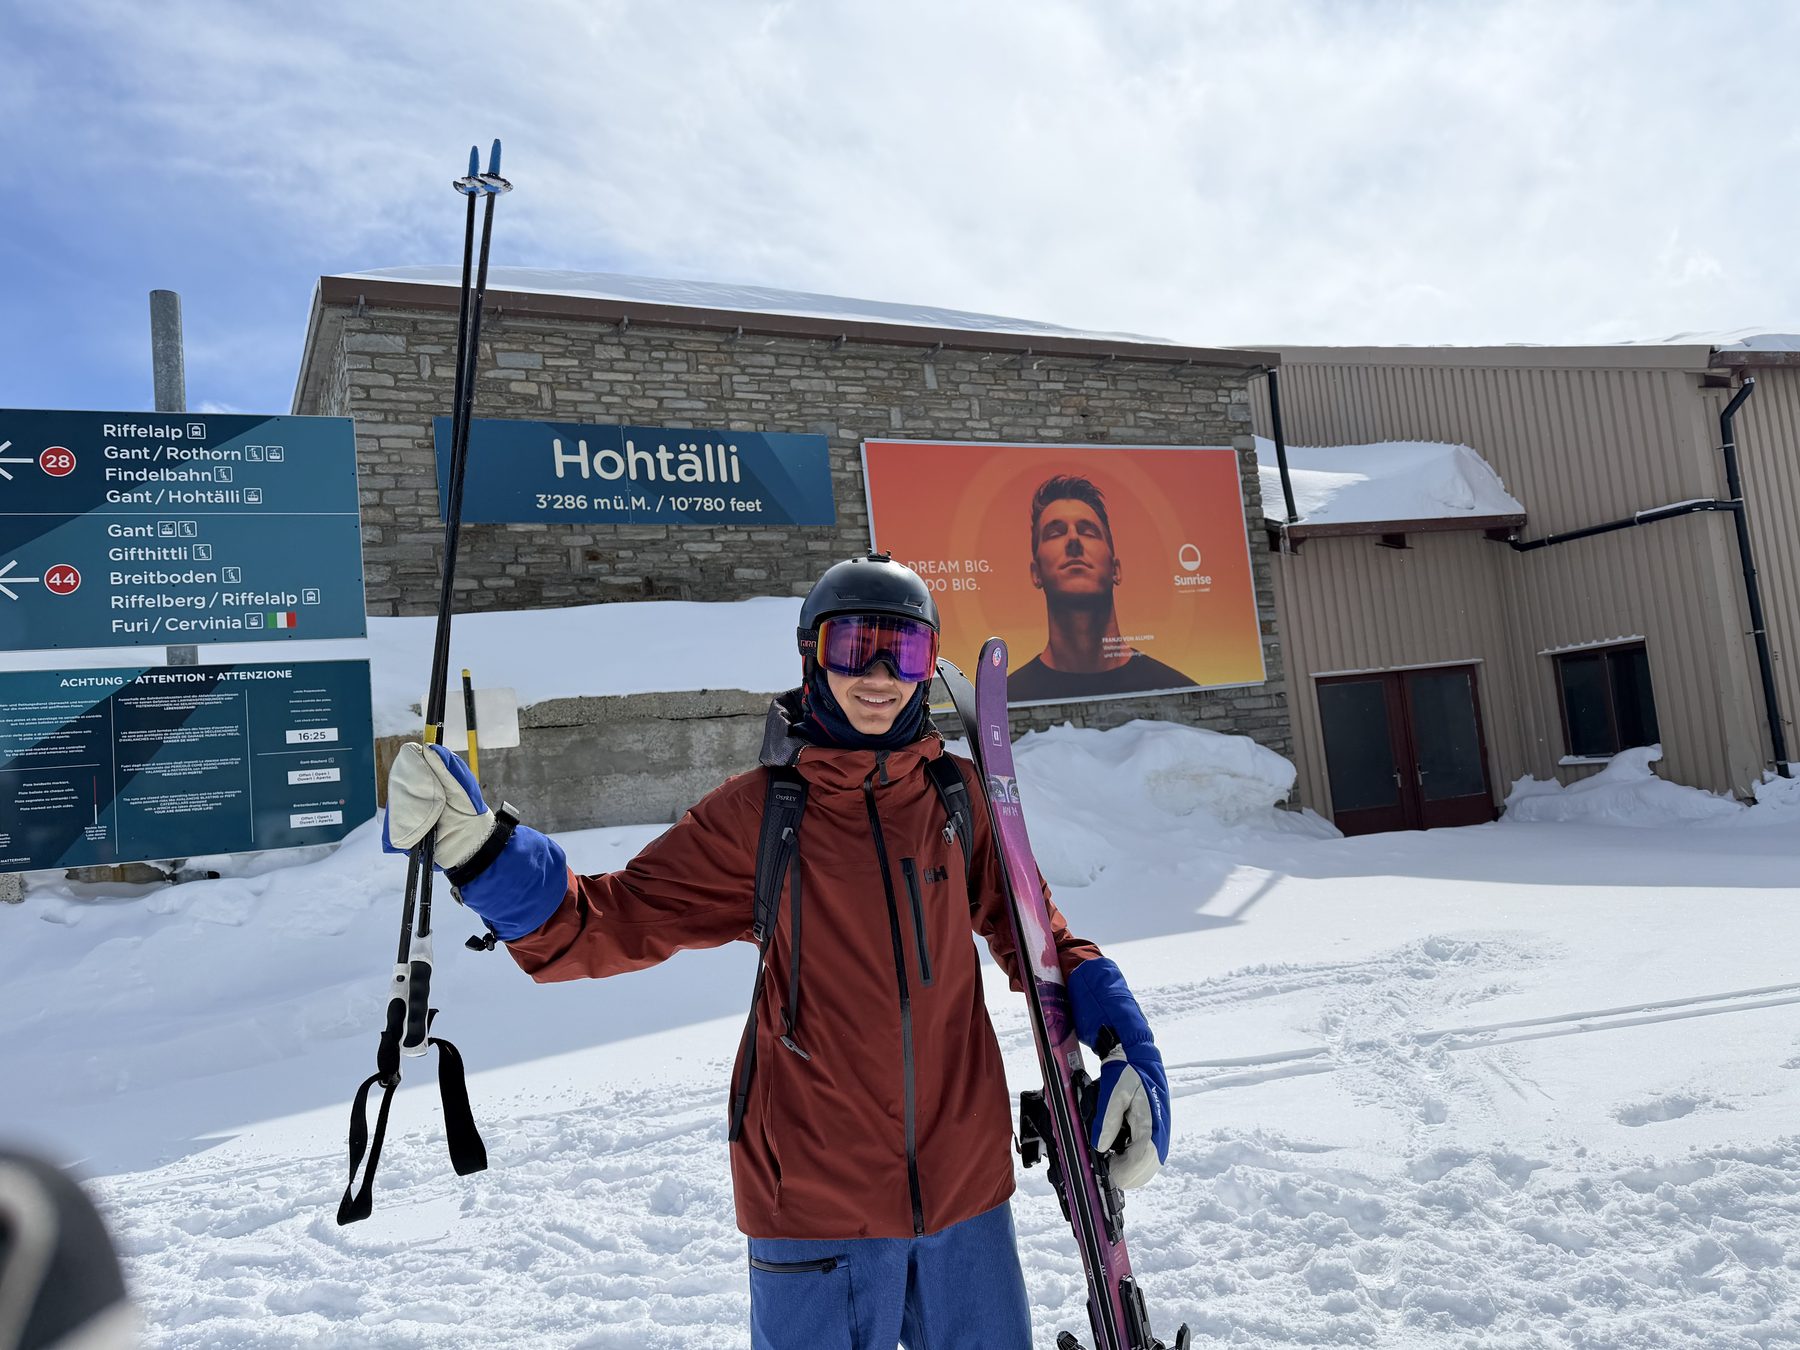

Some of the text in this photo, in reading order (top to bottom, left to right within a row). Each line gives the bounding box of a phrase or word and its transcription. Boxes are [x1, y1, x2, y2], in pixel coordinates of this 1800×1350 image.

[103, 424, 183, 442] Riffelalp
[45, 454, 70, 469] 28
[104, 446, 150, 460] Gant
[167, 447, 242, 462] Rothorn
[552, 438, 741, 484] Hohtälli
[105, 468, 212, 483] Findelbahn
[106, 490, 152, 504] Gant
[168, 489, 241, 504] Hohtälli
[730, 497, 762, 512] feet
[108, 524, 154, 538] Gant
[108, 546, 188, 562] Gifthittli
[908, 560, 993, 574] DREAM BIG.
[48, 574, 76, 587] 44
[110, 570, 217, 586] Breitboden
[952, 578, 981, 591] BIG.
[1174, 573, 1212, 586] Sunrise
[111, 594, 206, 612] Riffelberg
[222, 592, 298, 609] Riffelalp
[112, 618, 149, 633] Furi
[165, 616, 242, 632] Cervinia
[60, 676, 124, 688] ACHTUNG
[135, 672, 206, 686] ATTENTION
[216, 669, 293, 682] ATTENZIONE
[298, 731, 326, 741] 16:25
[776, 794, 797, 802] OSPREY
